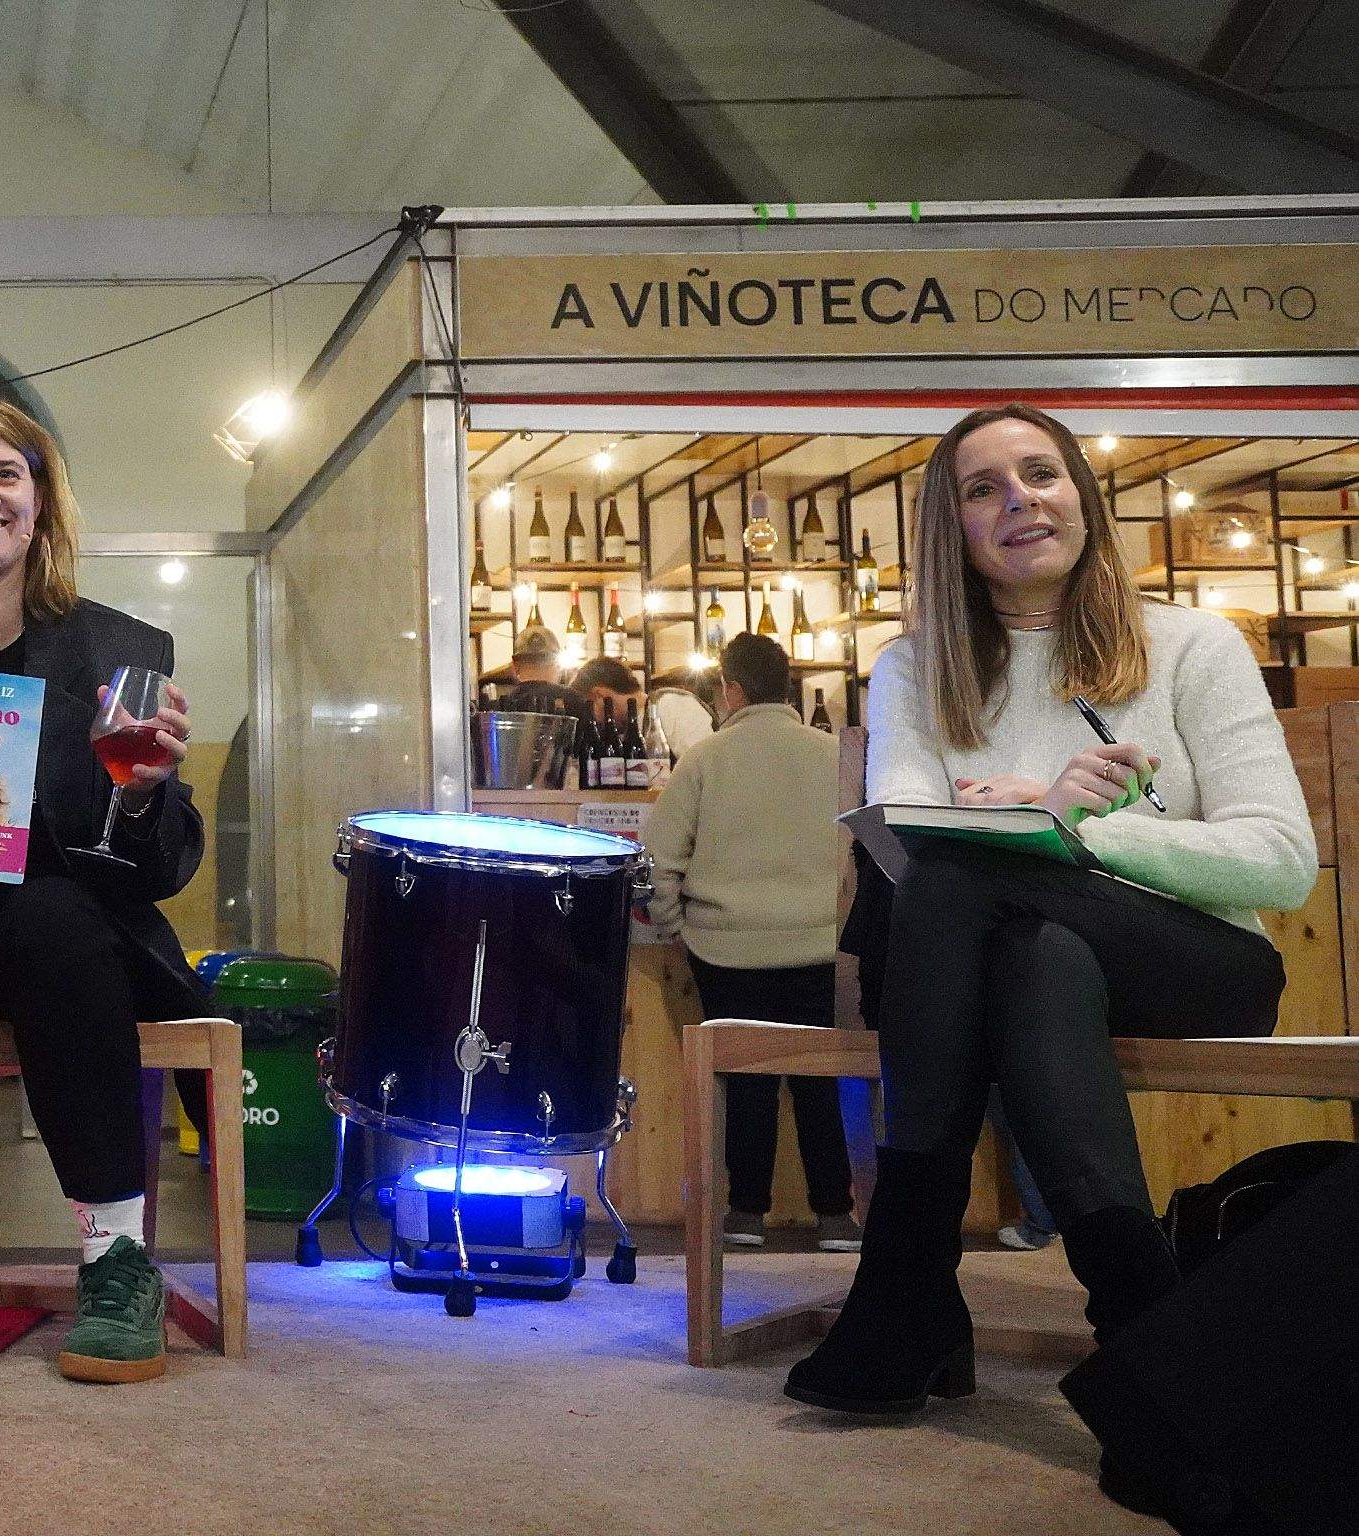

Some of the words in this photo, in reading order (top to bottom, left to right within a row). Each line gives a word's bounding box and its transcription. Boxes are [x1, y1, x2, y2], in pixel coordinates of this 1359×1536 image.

[550, 282, 596, 329] A
[609, 268, 958, 328] VIÑOTECA
[975, 288, 1046, 323] DO
